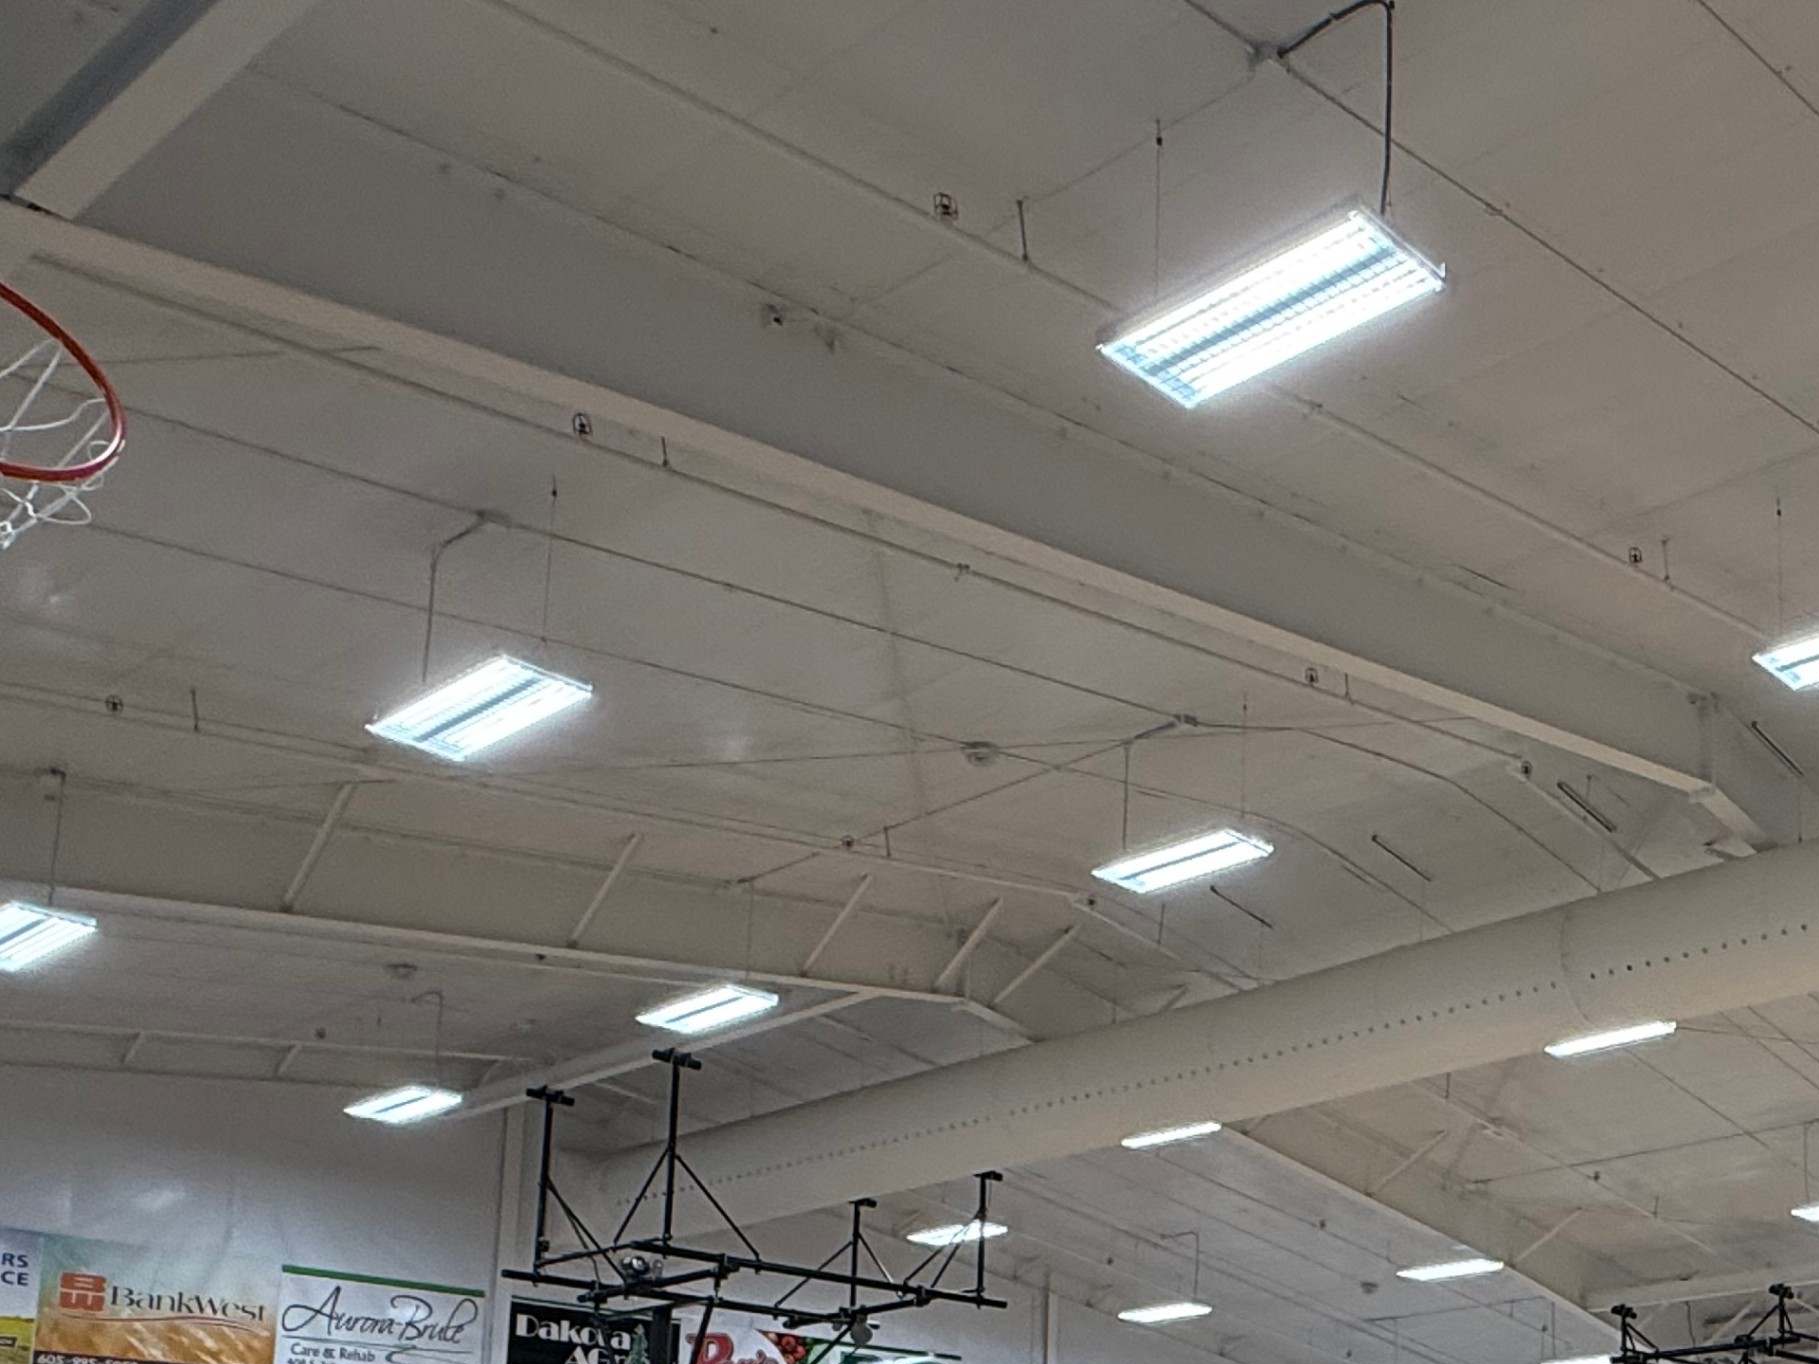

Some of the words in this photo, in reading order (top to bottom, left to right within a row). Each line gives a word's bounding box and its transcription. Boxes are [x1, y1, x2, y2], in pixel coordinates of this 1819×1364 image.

[110, 1285, 266, 1321] BankWest
[515, 1313, 631, 1350] Dakoa
[291, 1342, 320, 1357] Care
[339, 1347, 376, 1362] Rehab
